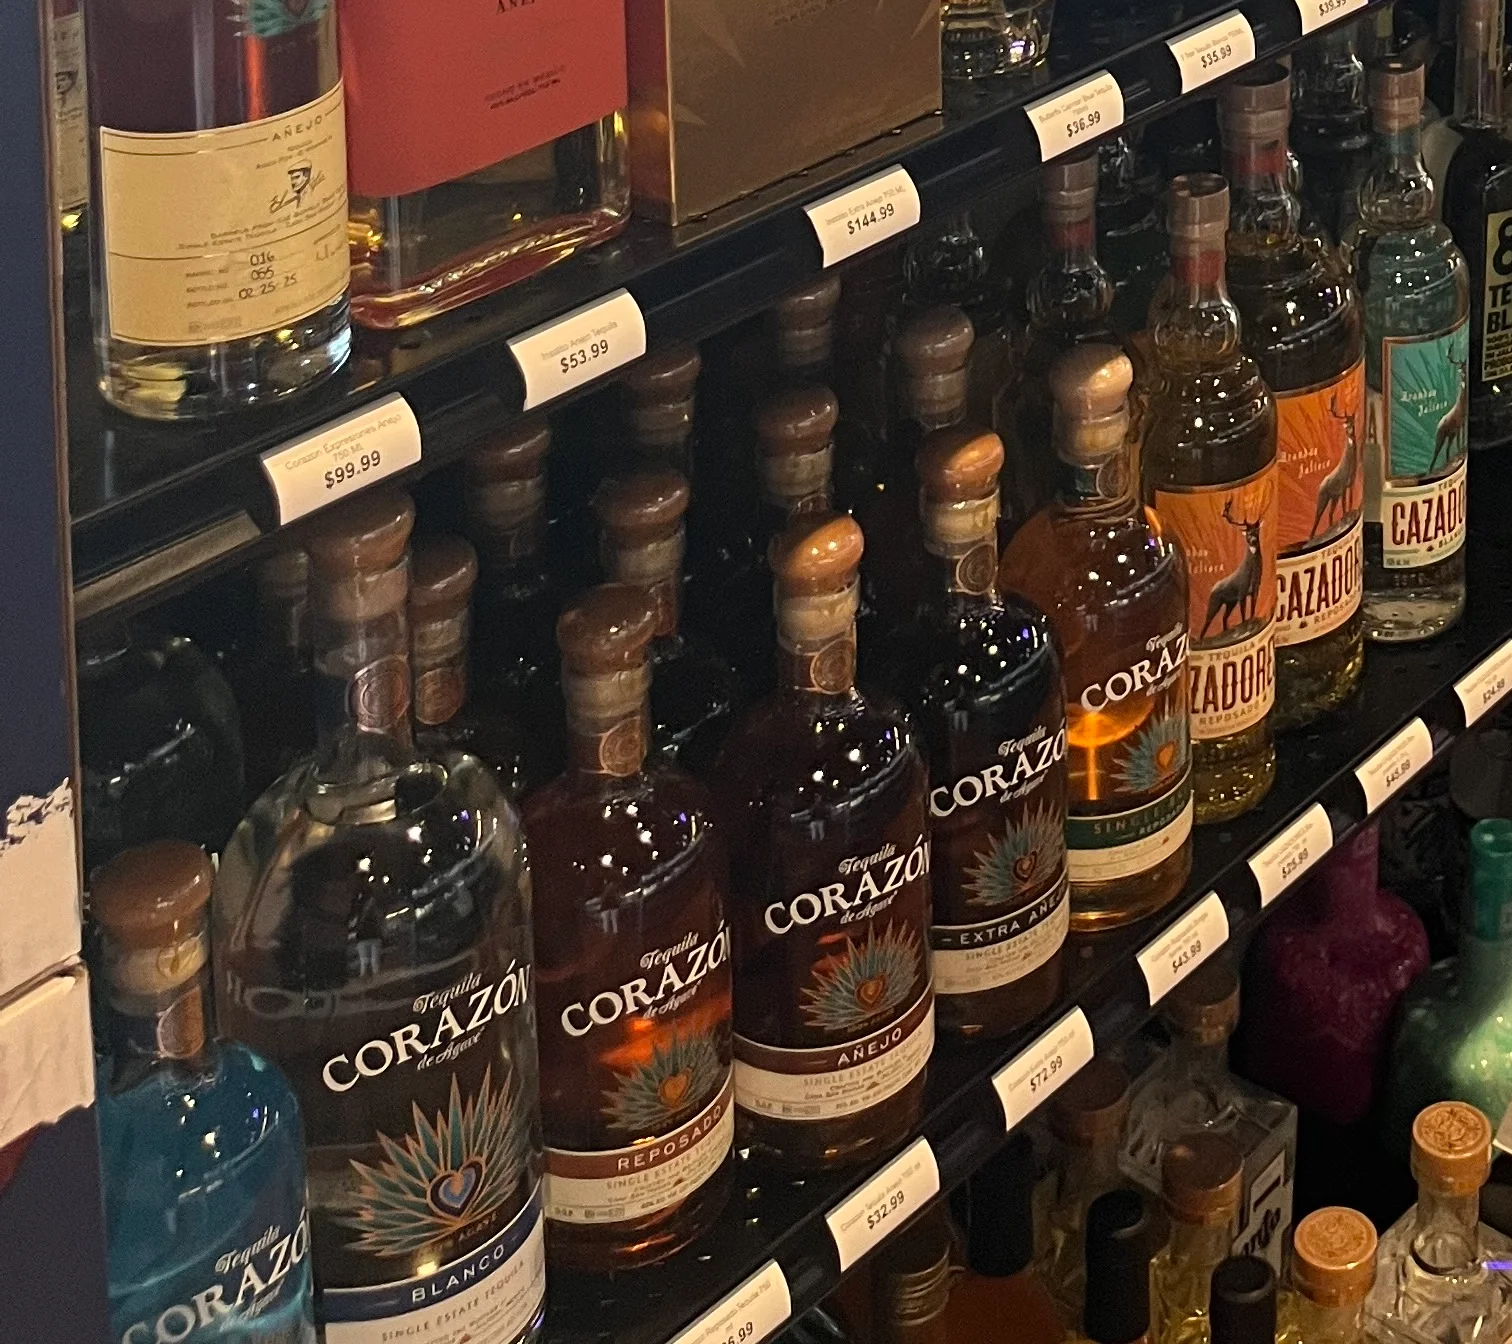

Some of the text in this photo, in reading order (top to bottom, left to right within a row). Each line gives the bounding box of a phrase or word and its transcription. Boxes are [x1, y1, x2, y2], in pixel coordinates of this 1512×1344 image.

[1200, 44, 1233, 69] $35.99
[272, 115, 323, 142] AÑEJO
[1066, 110, 1102, 138] $36.99
[847, 203, 895, 236] $144.99
[559, 338, 609, 375] $53.99
[324, 449, 382, 490] $99.99
[1275, 558, 1362, 624] CAZADORE
[1081, 624, 1189, 713] CORAZ
[998, 724, 1047, 758] Tequila
[930, 709, 1067, 817] CORAZÓ
[838, 843, 897, 878] Tequila
[763, 833, 931, 935] CORAZÓN
[639, 929, 699, 971] Tequila
[959, 919, 1021, 946] EXTRA
[412, 971, 484, 1014] Tequila
[560, 919, 732, 1037] CORAZÓN
[321, 959, 532, 1093] CORAZÓN
[836, 1026, 903, 1068] AÑEJO
[416, 1053, 435, 1072] de
[1029, 1055, 1063, 1093] $72.99
[616, 1104, 723, 1173] REPOSADO
[866, 1189, 905, 1230] $32.99
[213, 1224, 281, 1275] Tequila
[121, 1205, 309, 1344] CORAZÓ
[411, 1243, 506, 1304] BLANCO
